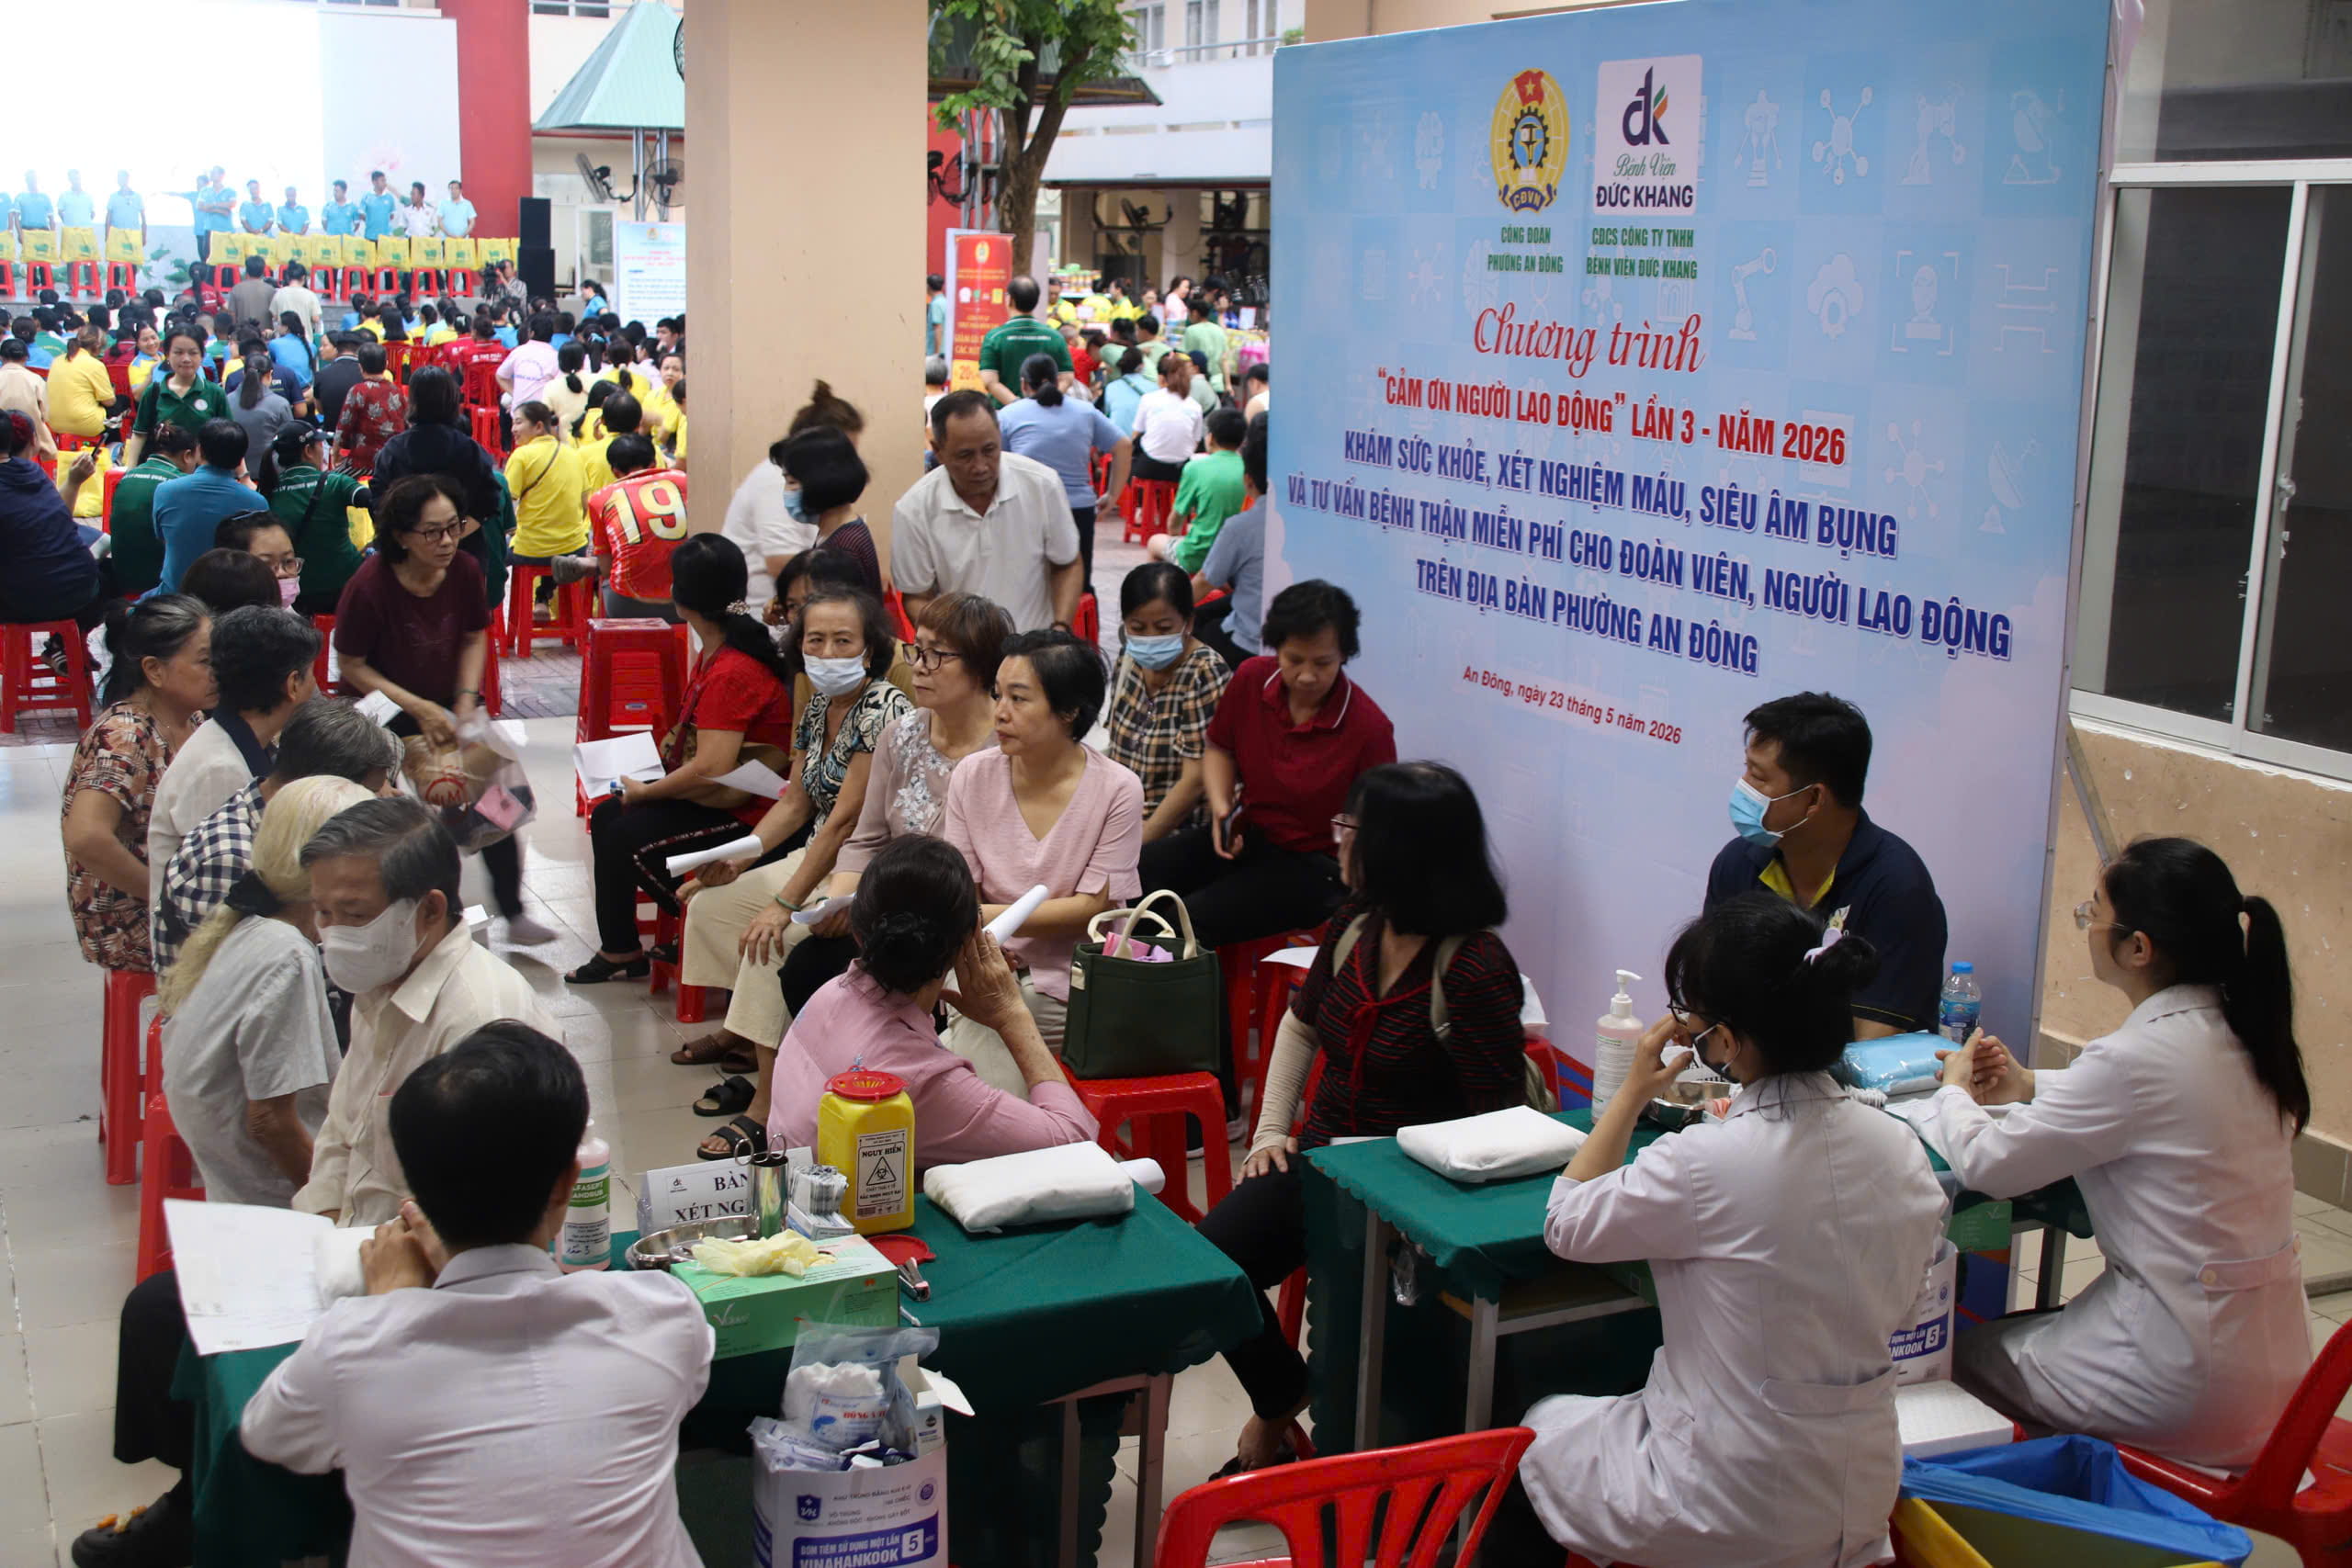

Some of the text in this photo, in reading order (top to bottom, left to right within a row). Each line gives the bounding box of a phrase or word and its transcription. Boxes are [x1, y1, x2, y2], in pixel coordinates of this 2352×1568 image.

[1613, 153, 1647, 180] Bệnh
[1596, 182, 1693, 208] ĐỨC KHANG
[1501, 224, 1524, 243] CÔNG
[1621, 225, 1648, 246] CÔNG
[1651, 229, 1664, 247] TY
[1667, 230, 1694, 248] TNHH
[1524, 255, 1536, 272] AN
[1539, 254, 1563, 273] ĐÔNG
[1662, 260, 1697, 279] KHANG
[1474, 302, 1706, 378] Chương trình
[1427, 381, 1452, 412] ƠN
[1456, 379, 1511, 420] NGƯỜI
[1516, 390, 1551, 425] LAO
[1632, 392, 1674, 445] LẦN
[1680, 410, 1694, 445] 3
[1717, 409, 1775, 456] NĂM
[1782, 422, 1846, 465] 2026
[1344, 428, 1898, 559] KHÁM SỨC KHỎE, XÉT NGHIỆM MÁU, SIÊU ÂM BỤNG
[602, 479, 687, 546] 19
[1288, 470, 2012, 660] VÀ TƯ VẤN BỆNH THẬN MIỄN PHÍ CHO ĐOÀN VIÊN, NGƯỜI LAO ĐỘNG
[1416, 558, 1758, 677] TRÊN ĐỊA BÀN PHƯỜNG AN ĐÔNG
[1463, 665, 1682, 745] An Đông, ngày 23 tháng 5 năm 2026
[862, 1148, 882, 1158] NGUY
[675, 1199, 747, 1224] XÉT NG
[1929, 1329, 1937, 1343] 5
[1890, 1341, 1924, 1357] NKOOK
[909, 1534, 919, 1551] 5
[800, 1548, 899, 1568] VINAHANKOOK
